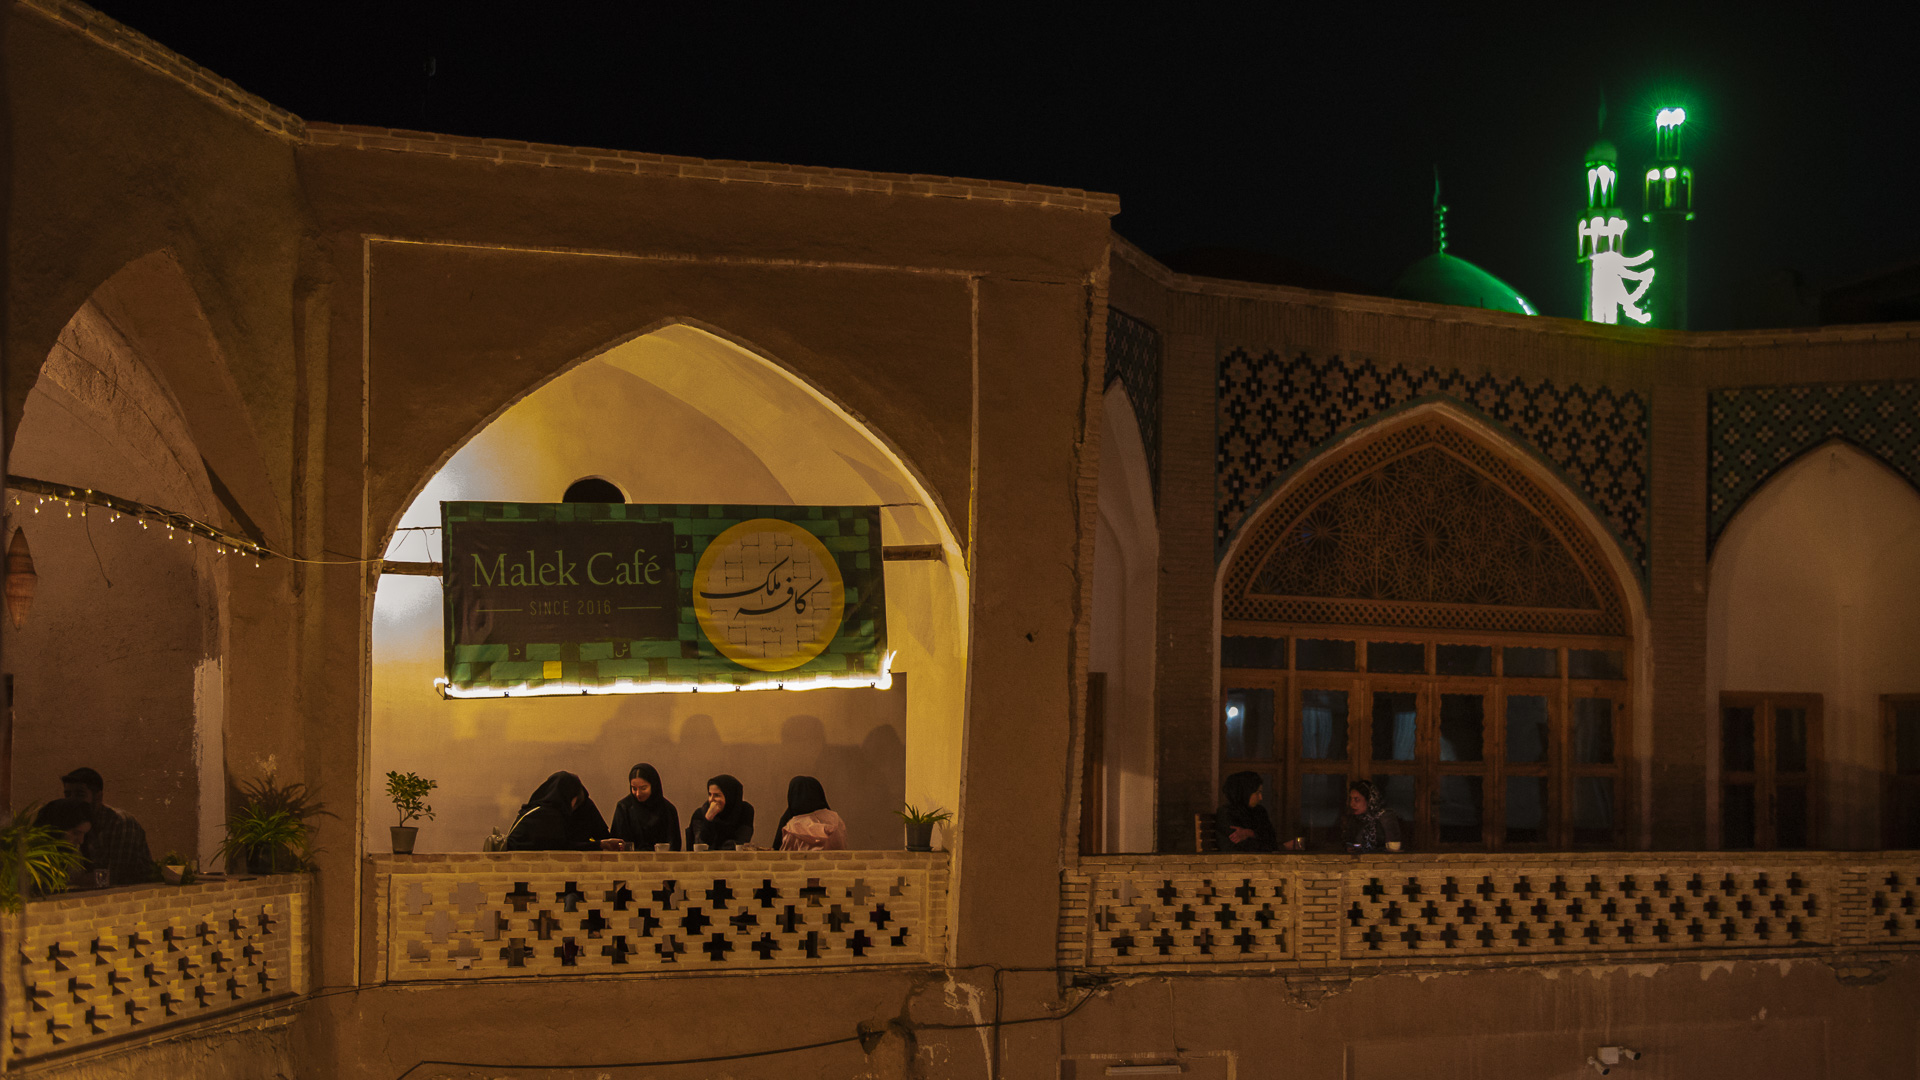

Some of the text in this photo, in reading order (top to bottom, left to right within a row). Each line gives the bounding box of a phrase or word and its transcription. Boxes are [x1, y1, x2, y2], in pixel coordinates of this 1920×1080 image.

[471, 548, 662, 587] Malek Café
[529, 600, 611, 616] SINCE 2016
